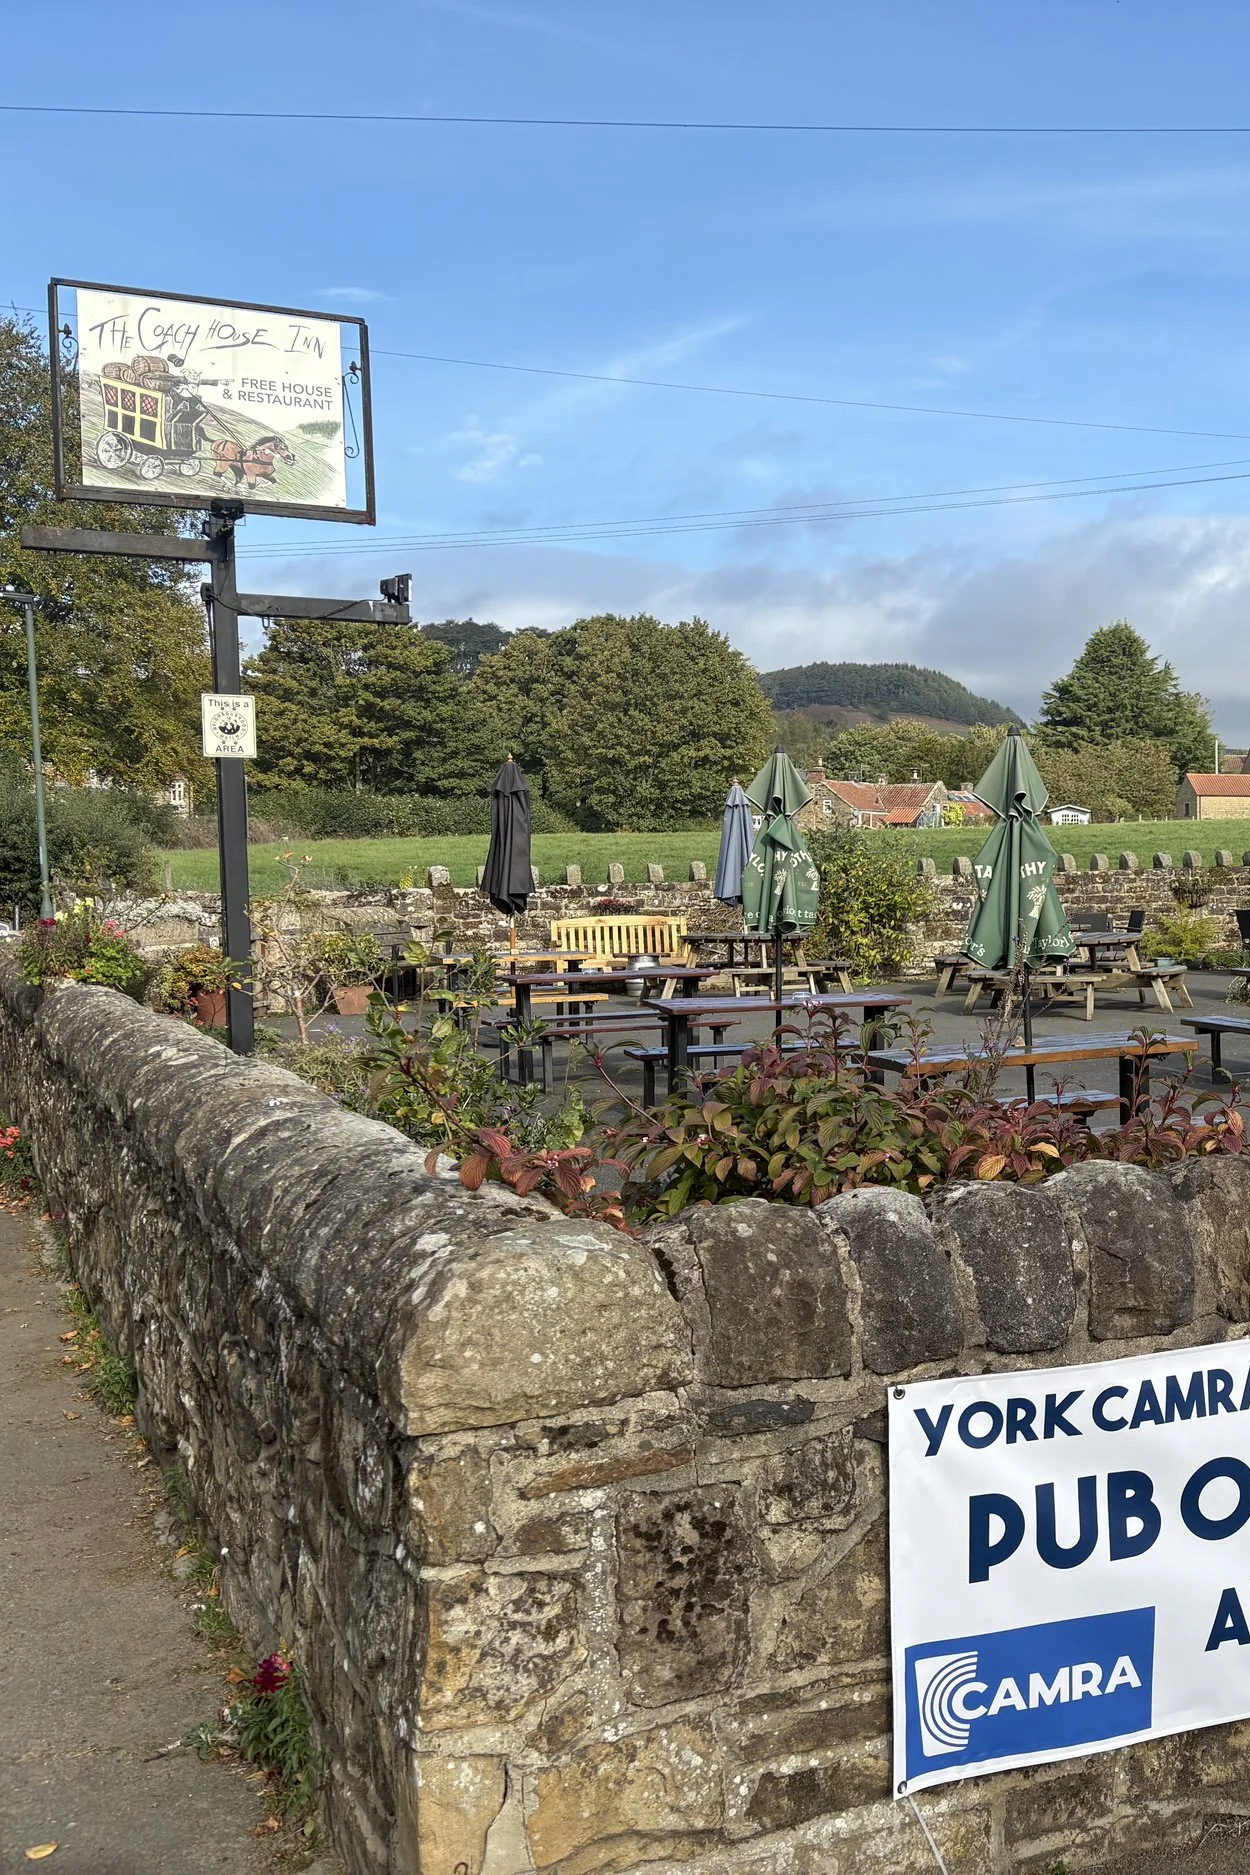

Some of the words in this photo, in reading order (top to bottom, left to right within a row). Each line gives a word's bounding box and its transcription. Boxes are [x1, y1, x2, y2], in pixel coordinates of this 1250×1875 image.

[89, 314, 134, 353] THE
[138, 307, 200, 362] COACH
[200, 319, 281, 352] HOUSE
[284, 324, 327, 359] INN
[222, 388, 233, 400] &
[238, 389, 333, 411] RESTAURANT
[241, 377, 277, 392] FREE
[282, 382, 332, 398] HOUSE
[208, 698, 230, 707] This
[232, 699, 240, 707] is
[215, 744, 245, 753] AREA
[914, 1391, 1083, 1457] YORK
[969, 1471, 1162, 1584] PUB
[951, 1655, 1143, 1720] CAMRA
